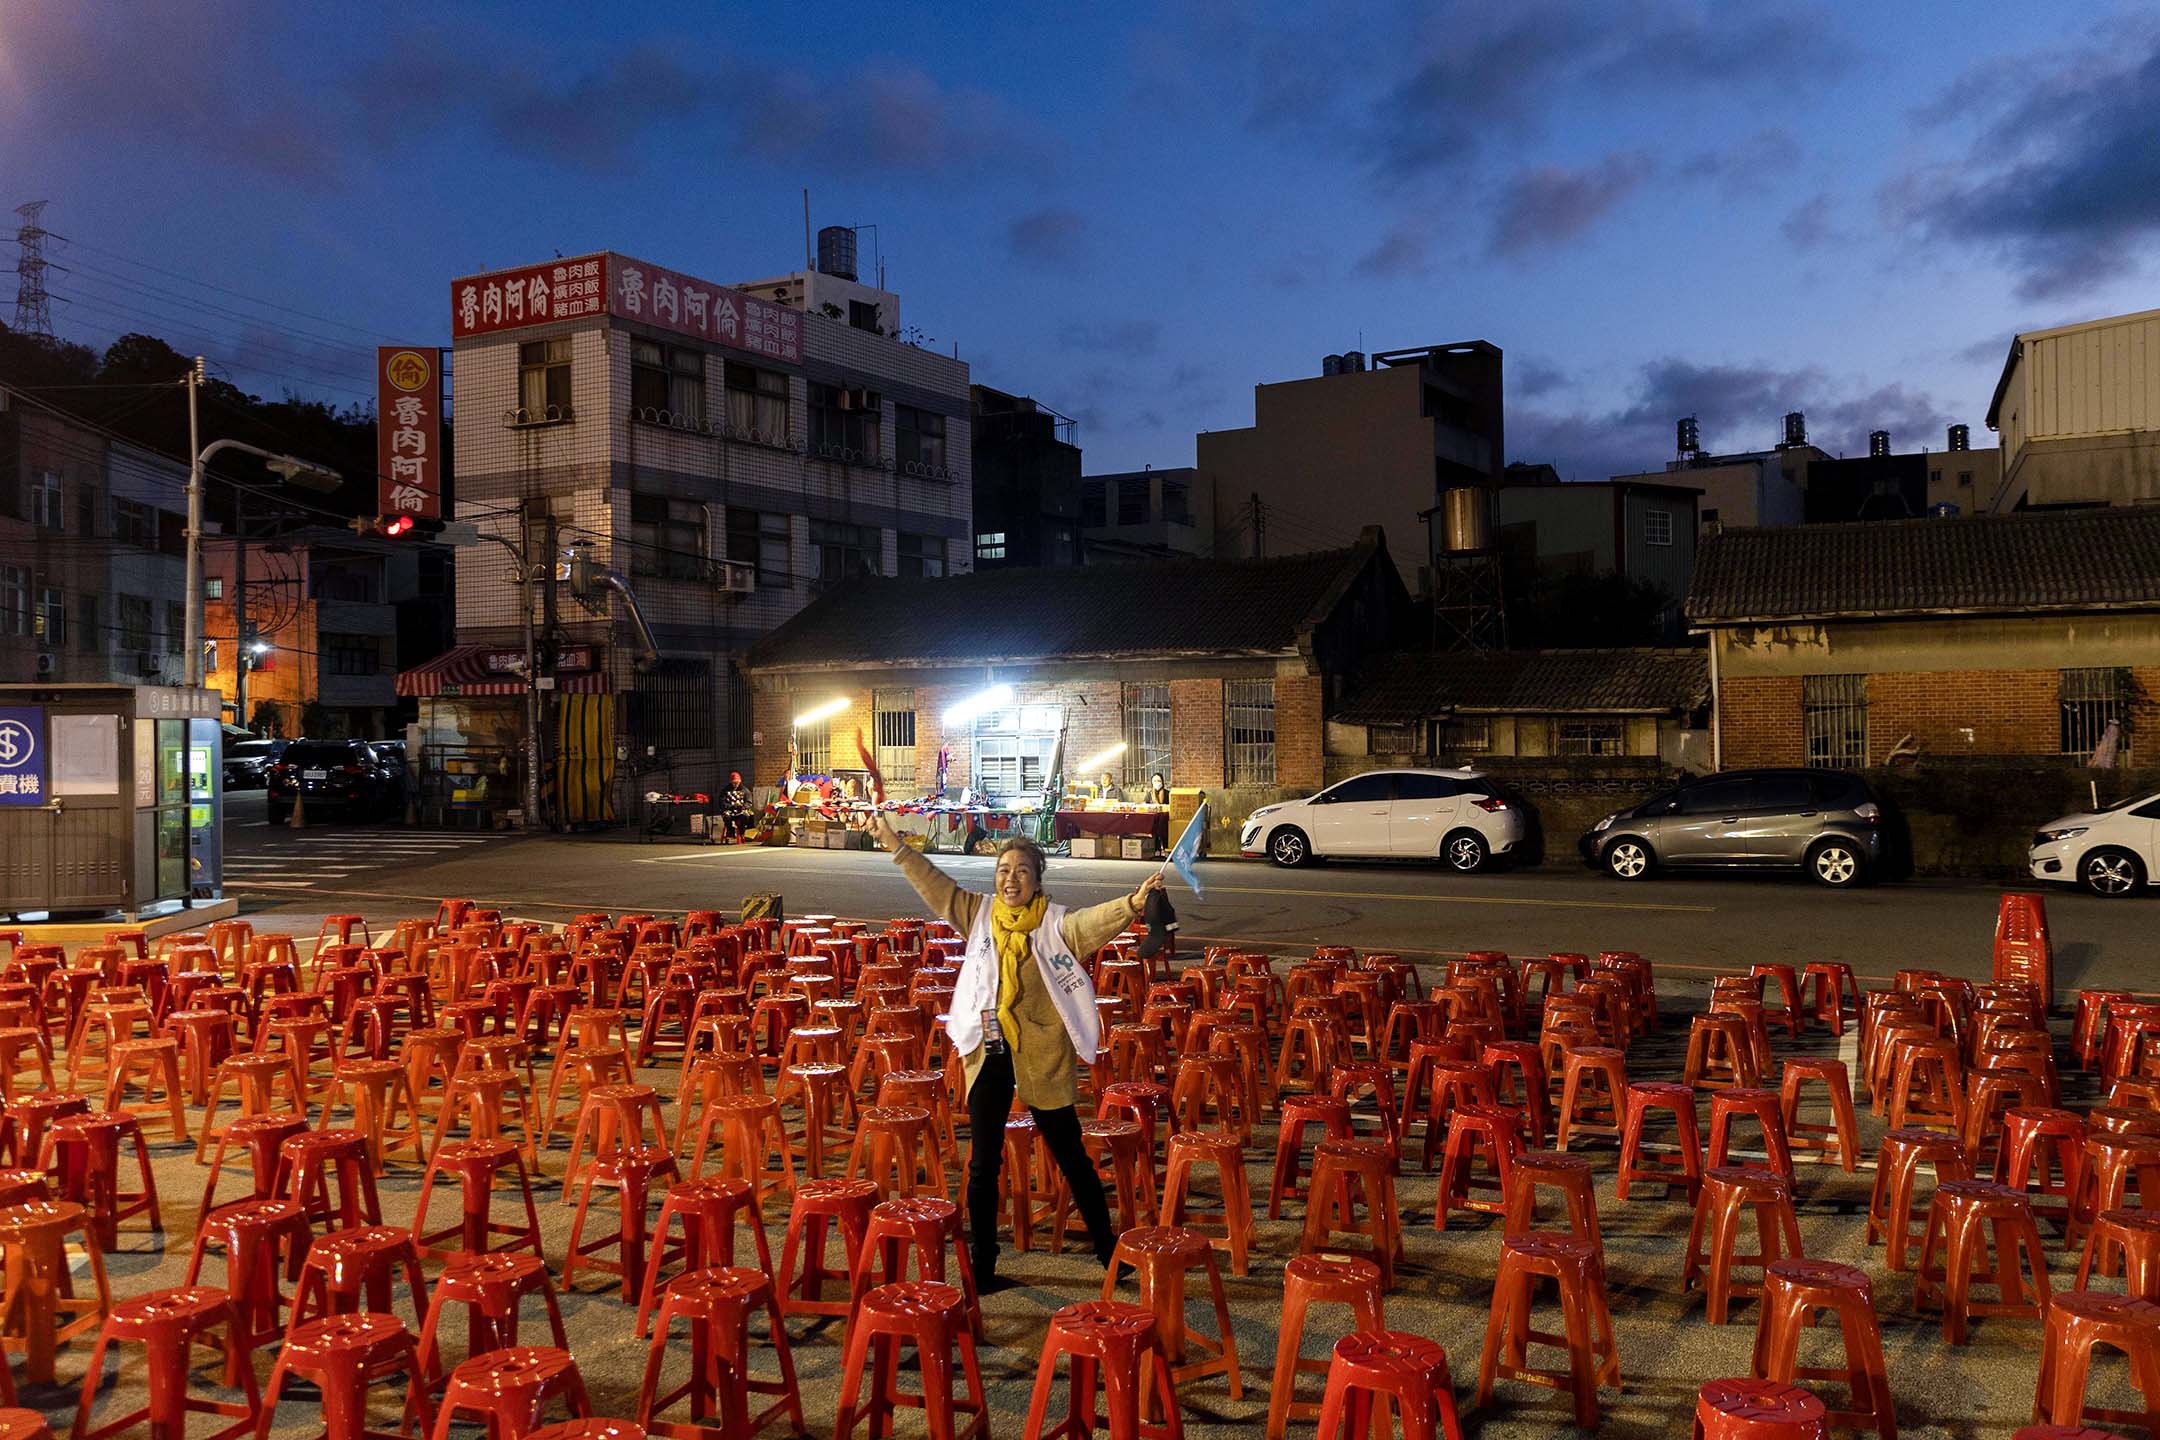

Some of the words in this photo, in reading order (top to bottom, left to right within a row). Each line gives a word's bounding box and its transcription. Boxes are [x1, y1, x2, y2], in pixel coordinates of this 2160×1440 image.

[553, 260, 600, 282] 魯肉飯
[459, 274, 550, 330] 魯肉阿倫
[618, 267, 740, 340] 魯肉阿倫
[391, 358, 425, 385] 倫
[389, 396, 430, 512] 魯肉阿倫
